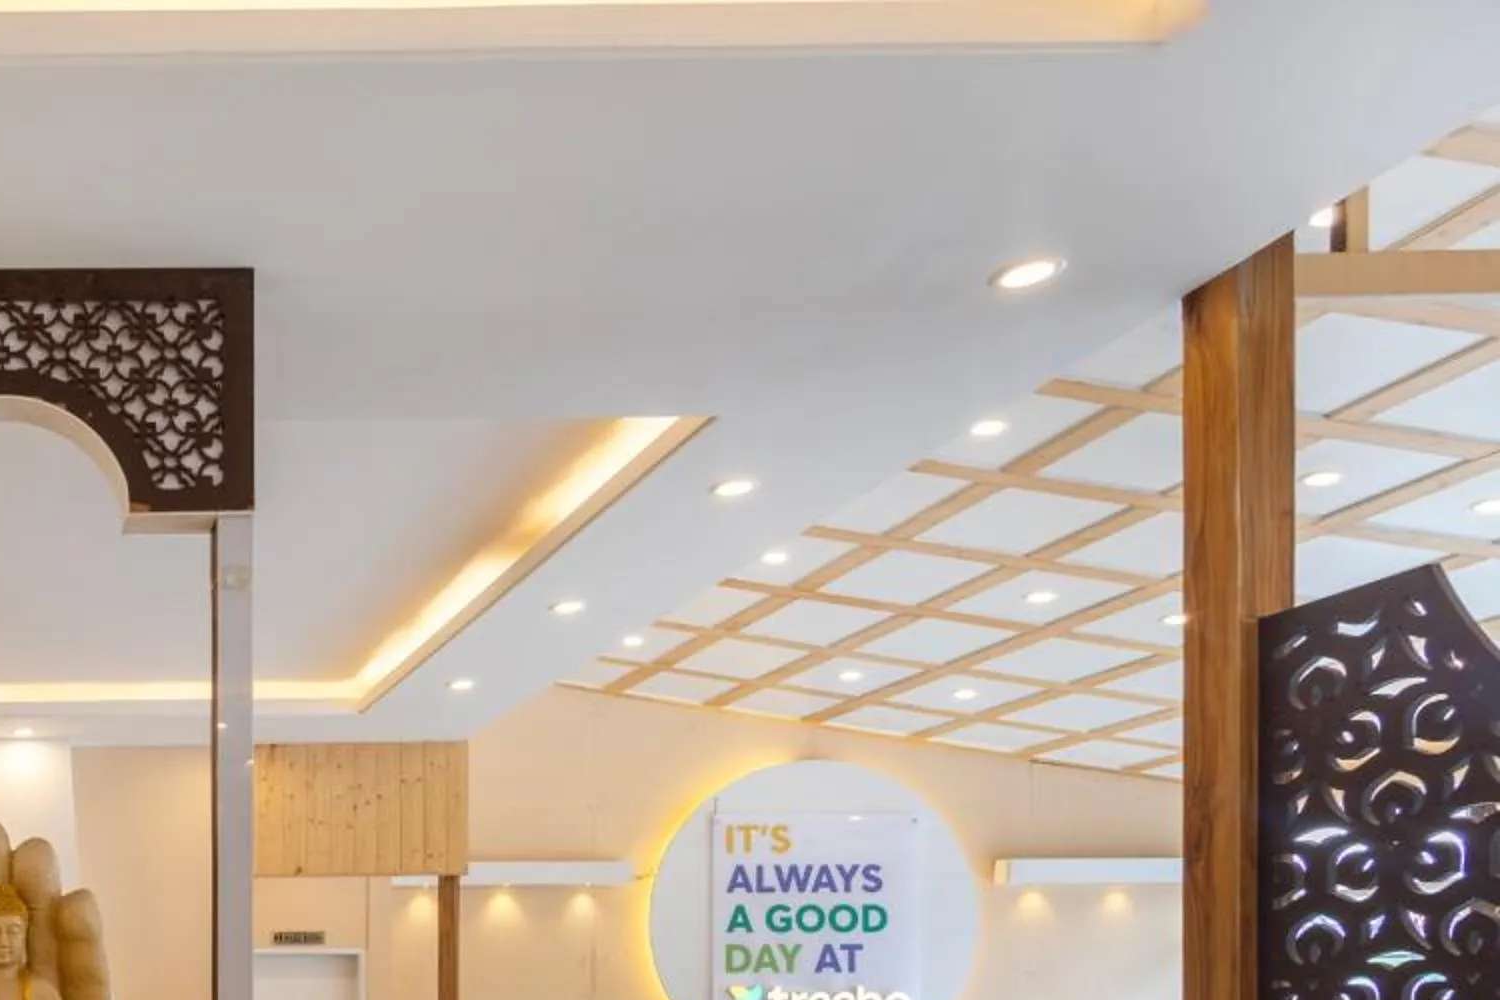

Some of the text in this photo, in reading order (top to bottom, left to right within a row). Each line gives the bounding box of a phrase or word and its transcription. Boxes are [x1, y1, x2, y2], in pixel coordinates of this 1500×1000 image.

[725, 824, 792, 854] IT'S
[726, 864, 883, 894] ALWAYS
[725, 904, 888, 934] A GOOD
[725, 944, 864, 975] DAY AT
